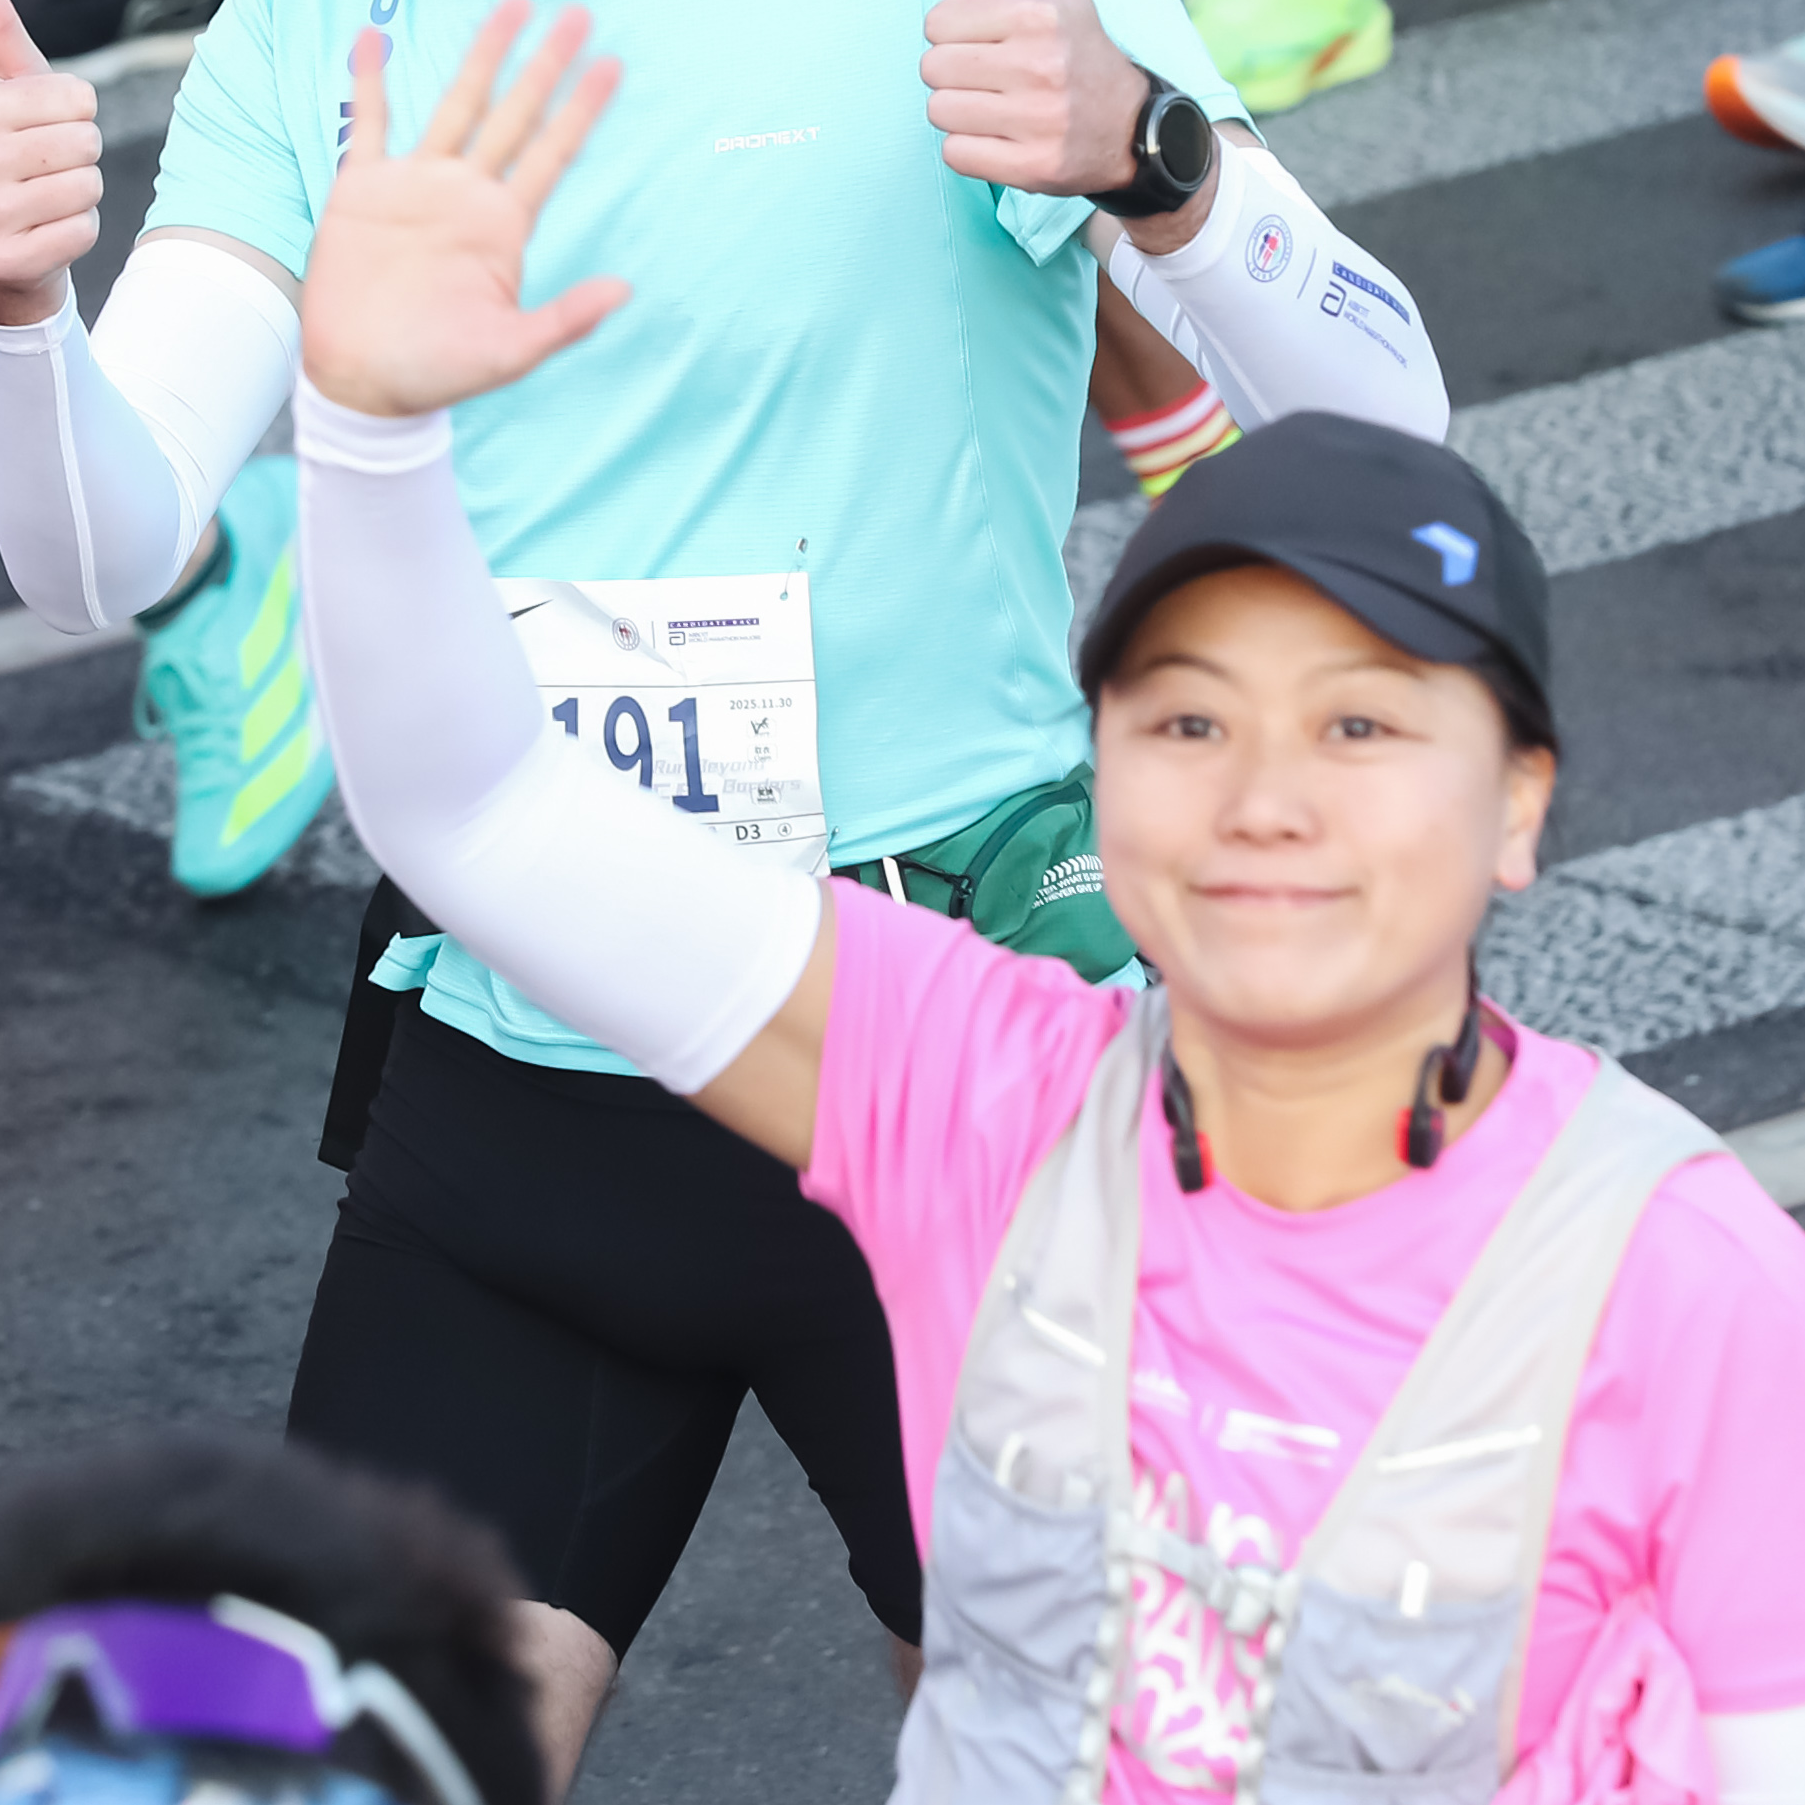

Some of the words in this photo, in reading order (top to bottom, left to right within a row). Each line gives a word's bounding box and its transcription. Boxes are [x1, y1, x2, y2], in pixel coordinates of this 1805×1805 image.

[729, 697, 793, 710] 2025.11.30
[735, 823, 762, 841] D3
[1044, 885, 1076, 904] NEVER
